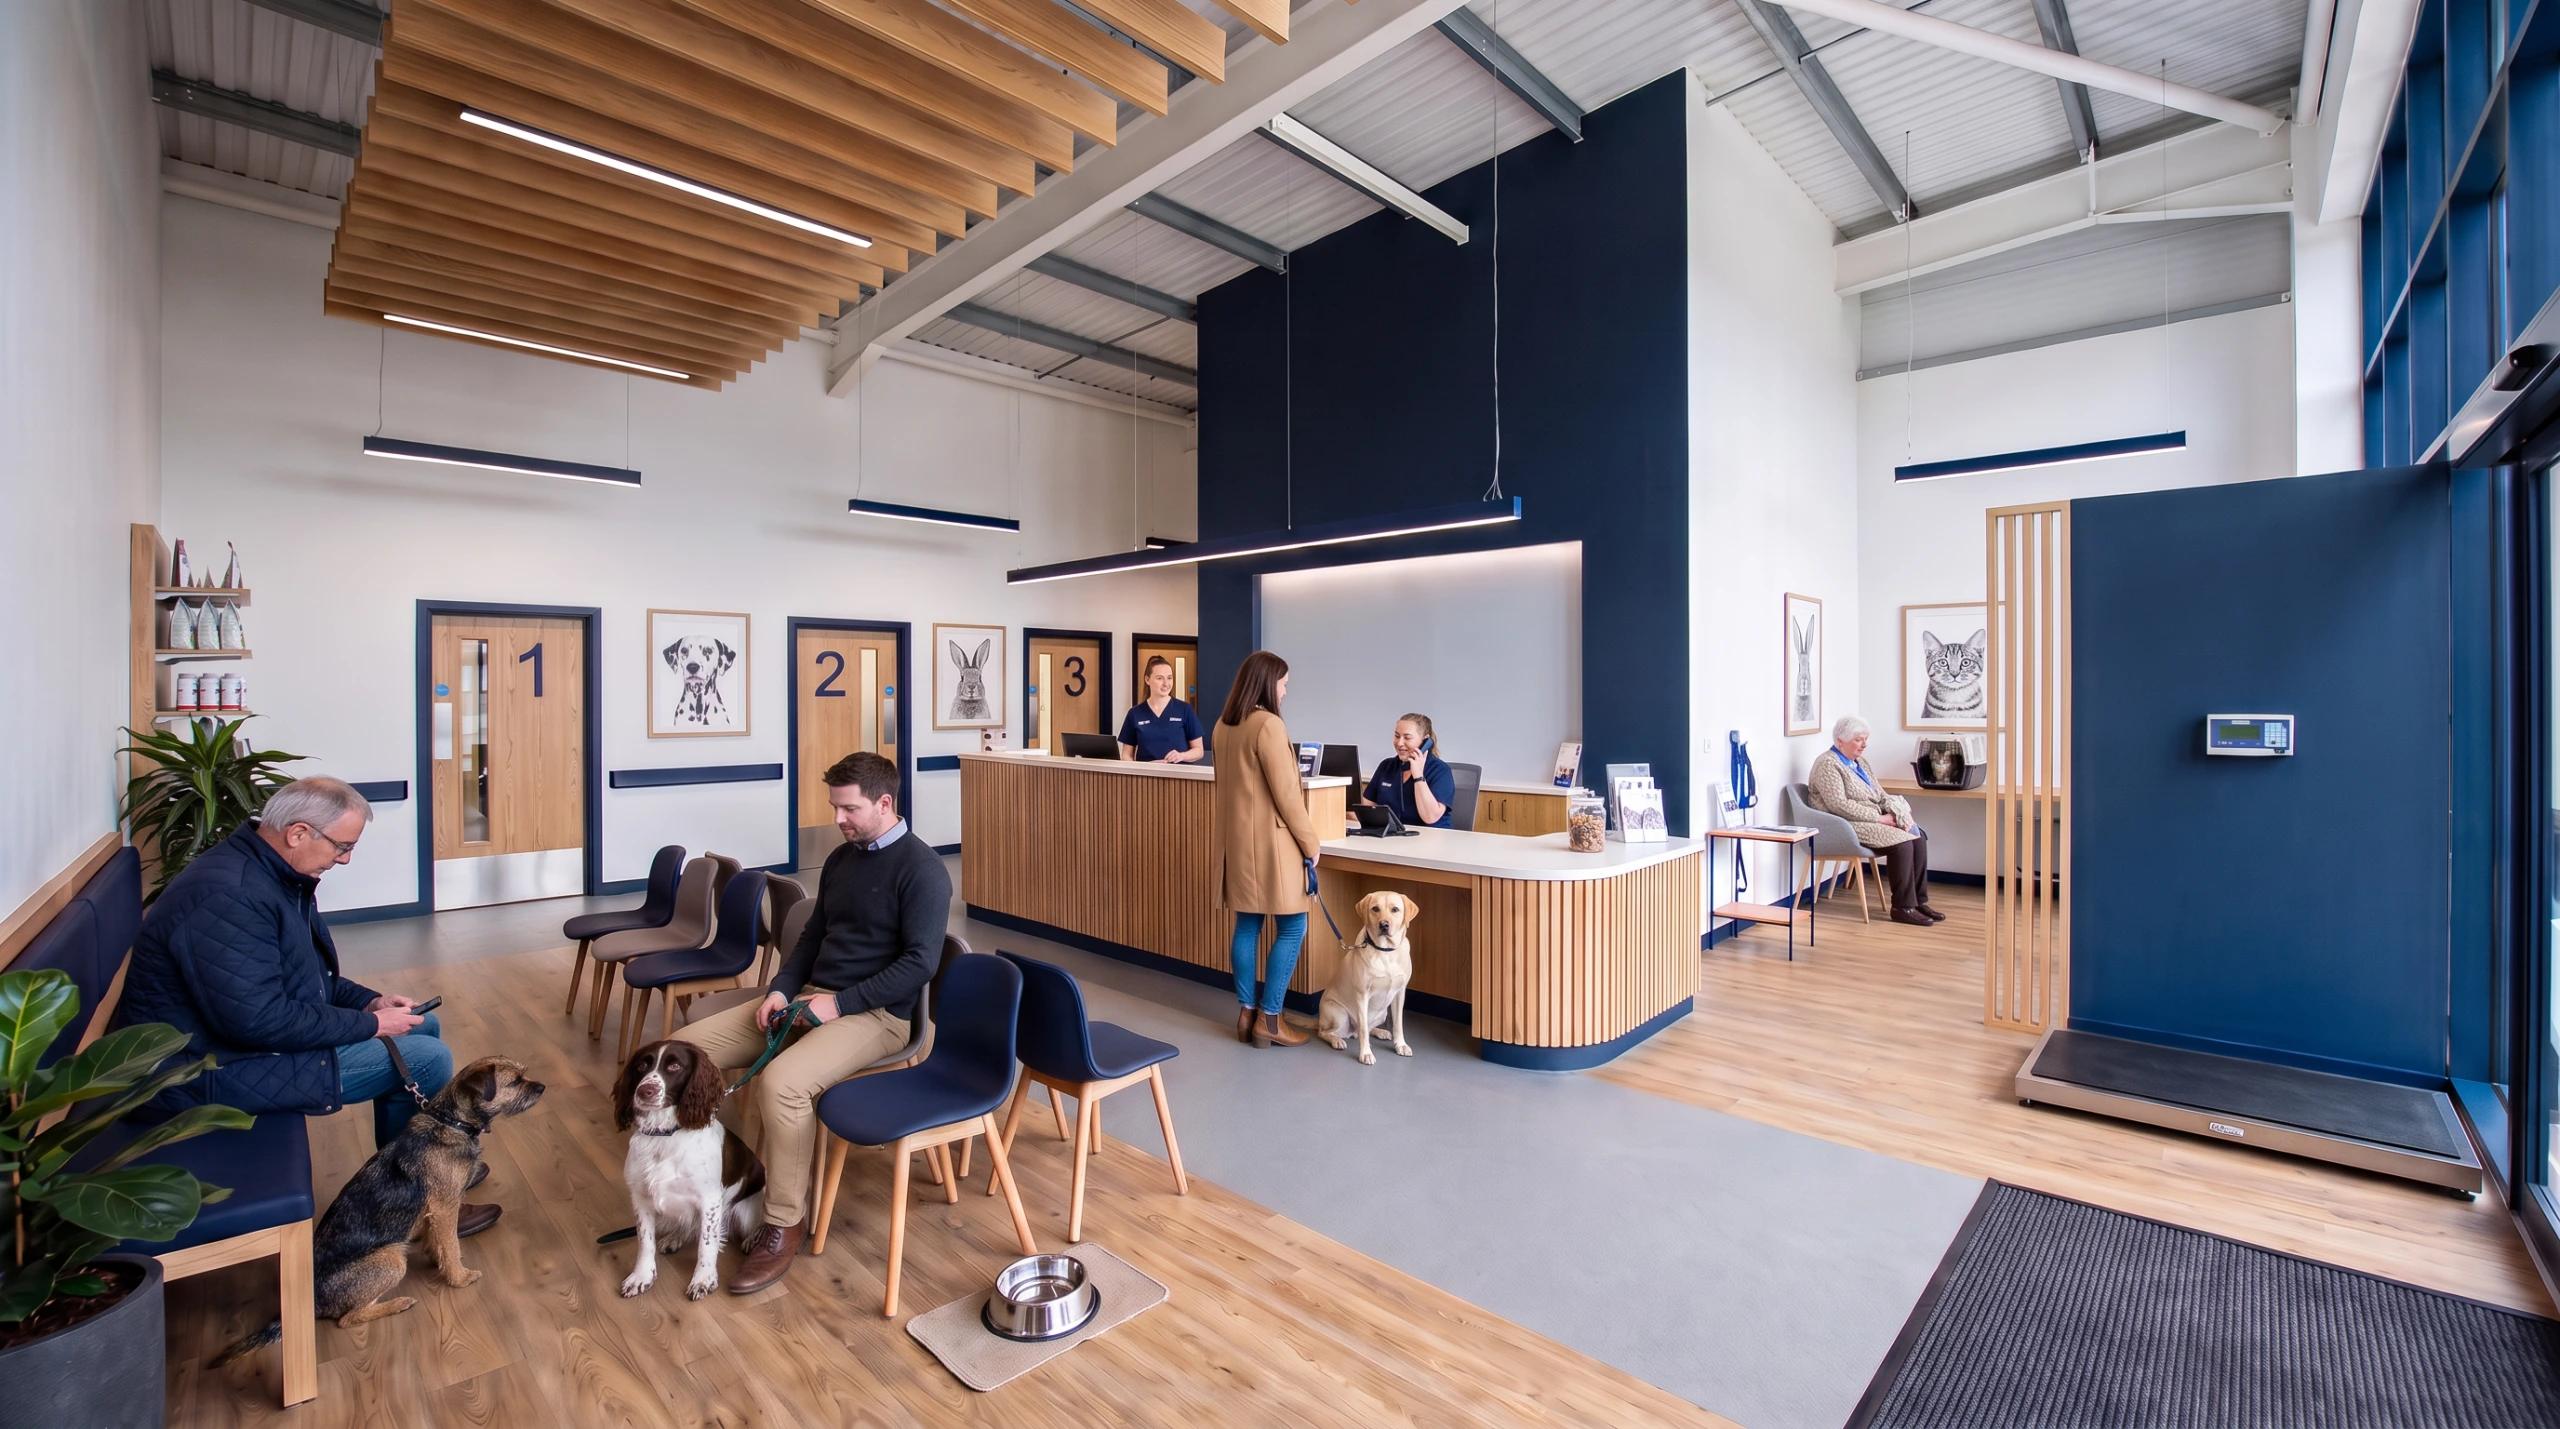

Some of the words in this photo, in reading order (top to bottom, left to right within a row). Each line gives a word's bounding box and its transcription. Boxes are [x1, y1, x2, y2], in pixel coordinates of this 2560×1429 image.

[519, 643, 542, 697] 1
[815, 651, 845, 697] 2
[1064, 656, 1086, 697] 3
